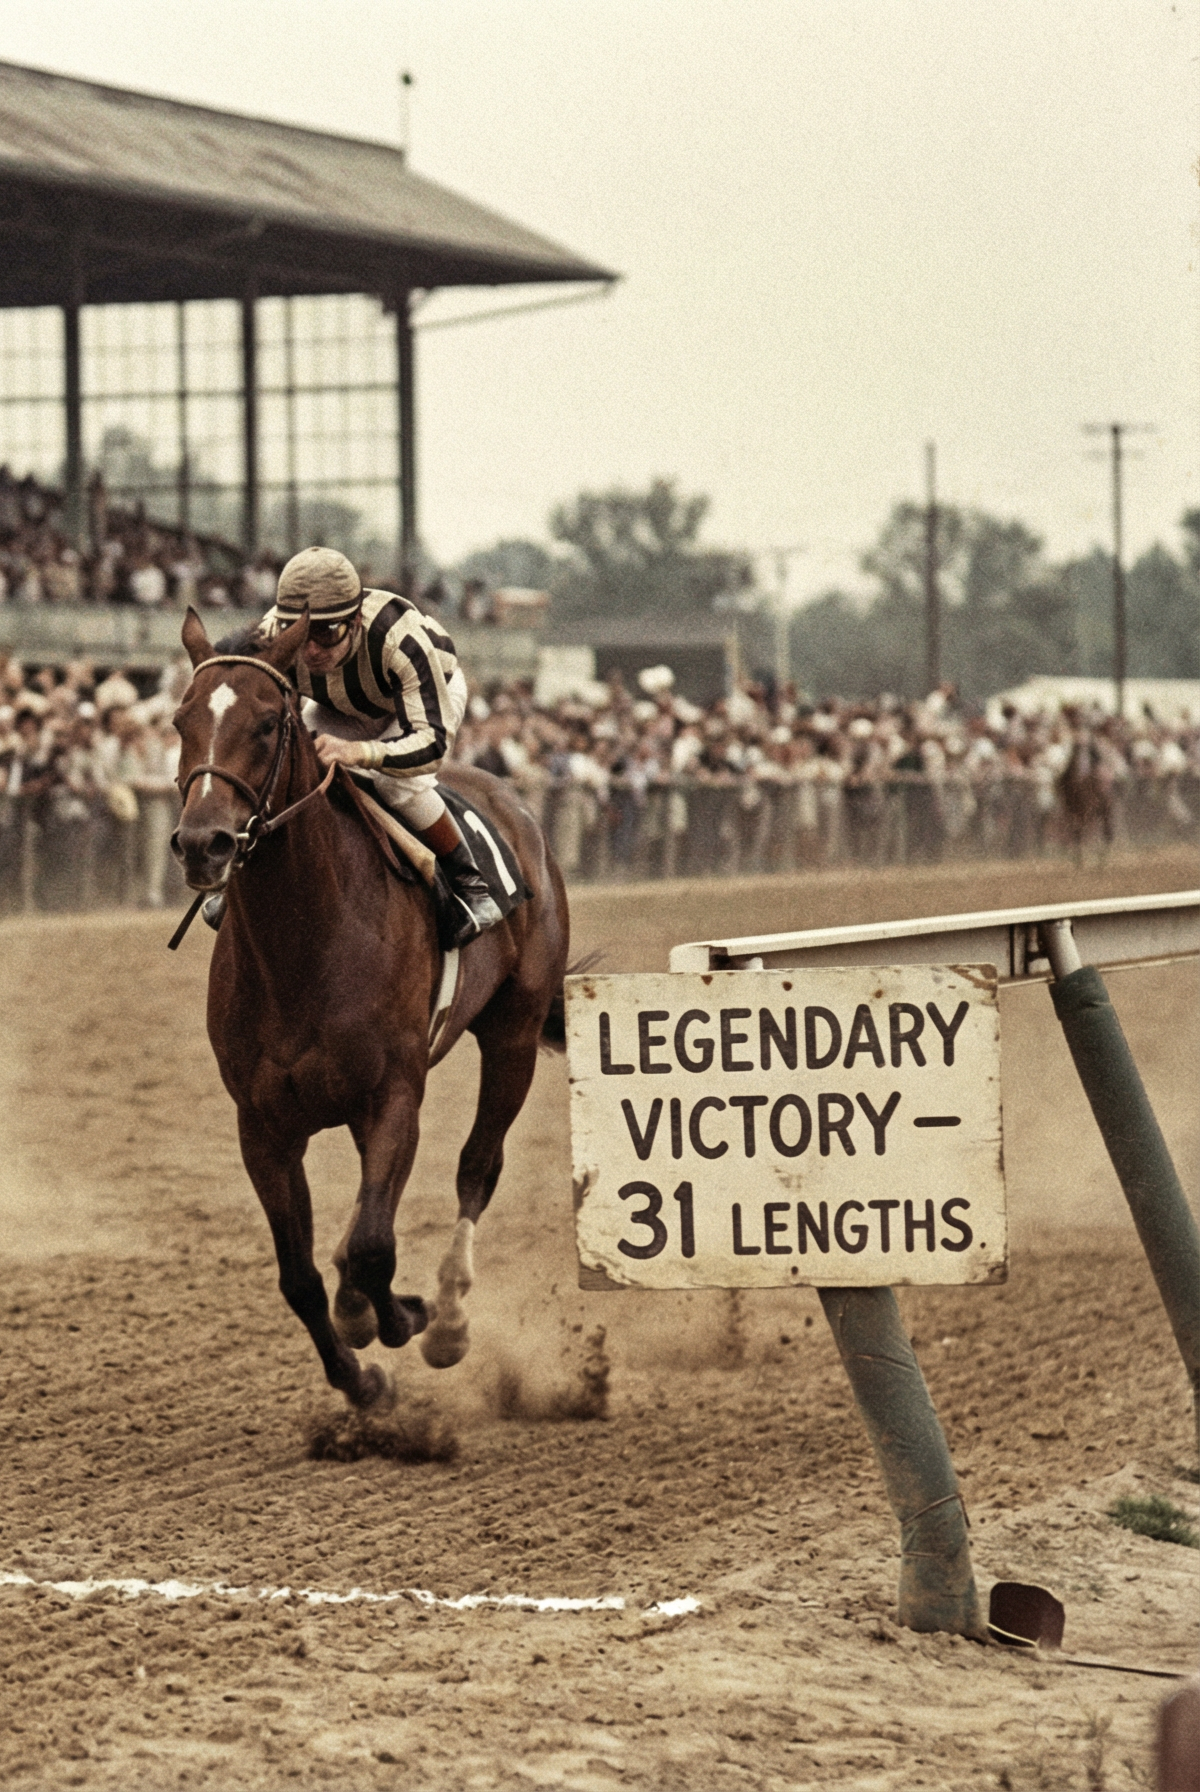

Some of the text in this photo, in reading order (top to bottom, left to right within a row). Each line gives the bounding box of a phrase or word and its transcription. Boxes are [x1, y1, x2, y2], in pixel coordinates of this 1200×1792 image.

[464, 811, 515, 894] 1
[600, 1001, 969, 1074] LEGENDARY
[618, 1181, 972, 1259] 31 LENGTHS
